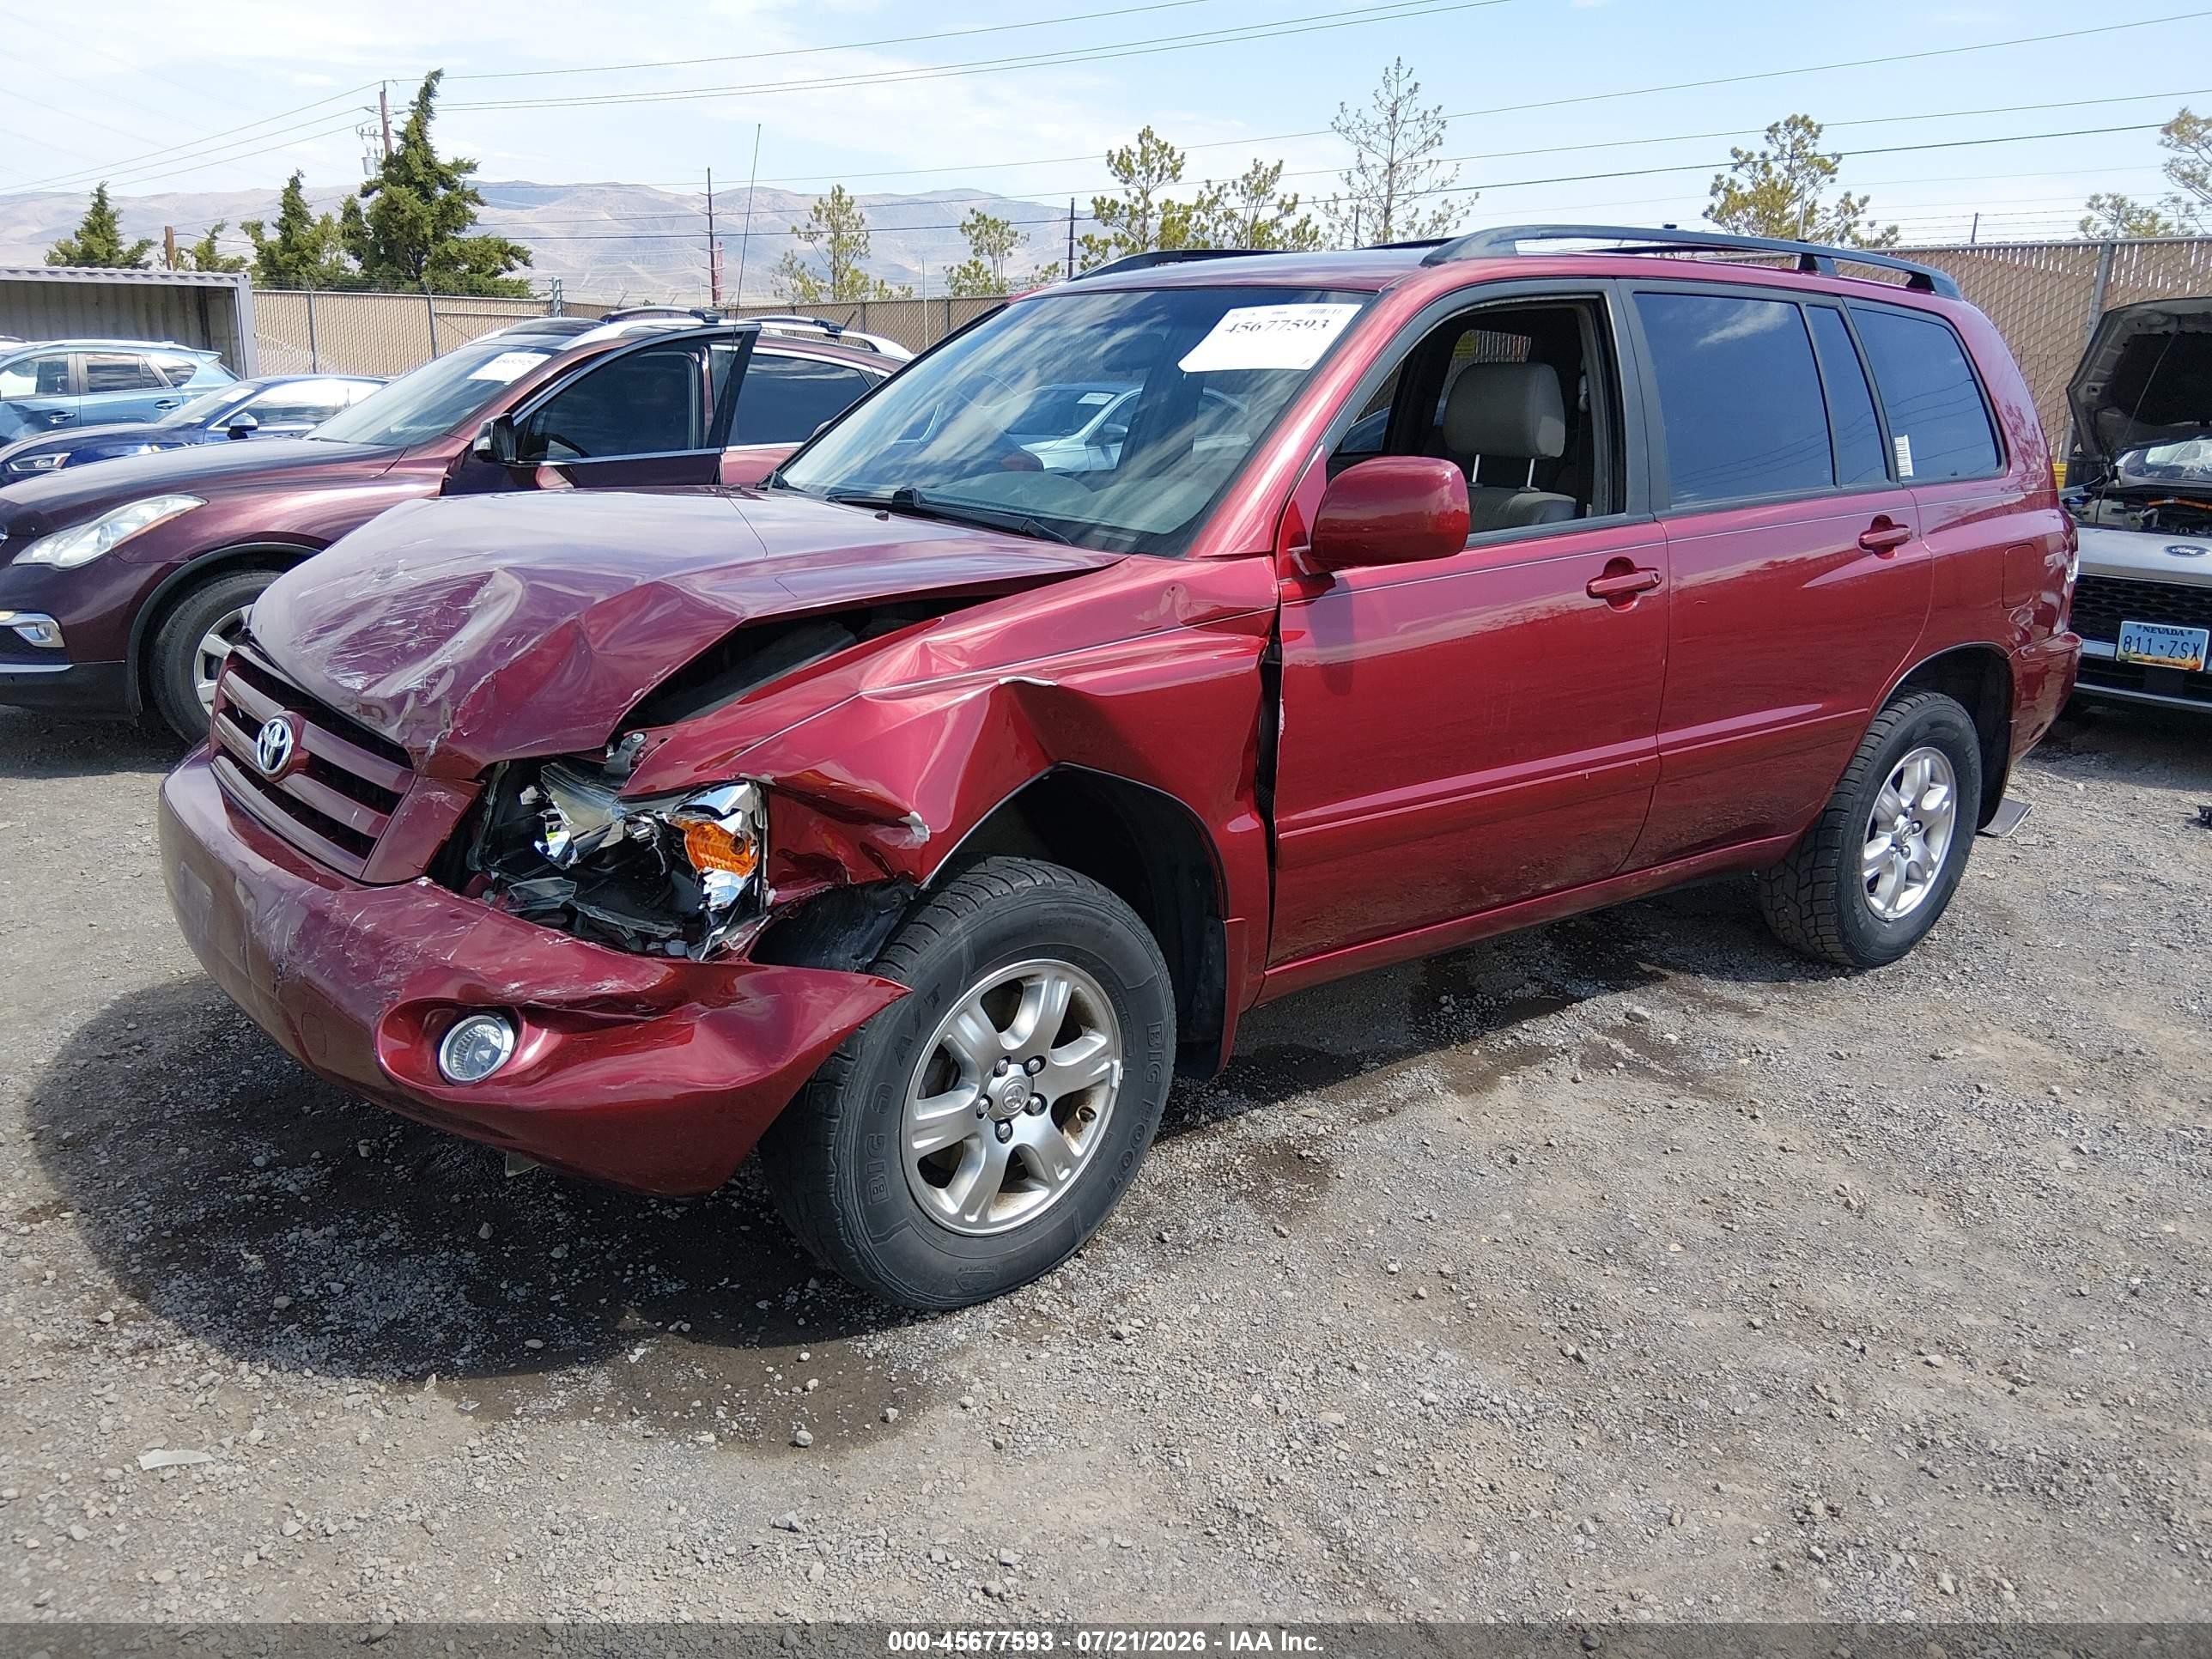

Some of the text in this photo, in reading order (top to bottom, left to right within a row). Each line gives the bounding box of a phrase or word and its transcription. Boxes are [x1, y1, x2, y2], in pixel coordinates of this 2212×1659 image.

[1224, 319, 1330, 334] 45677593
[2172, 546, 2200, 556] Ford
[2142, 626, 2185, 637] NEVADA
[2123, 635, 2201, 661] 811 ZSX
[1146, 1022, 1164, 1085] BIG
[866, 1133, 890, 1205] BIG
